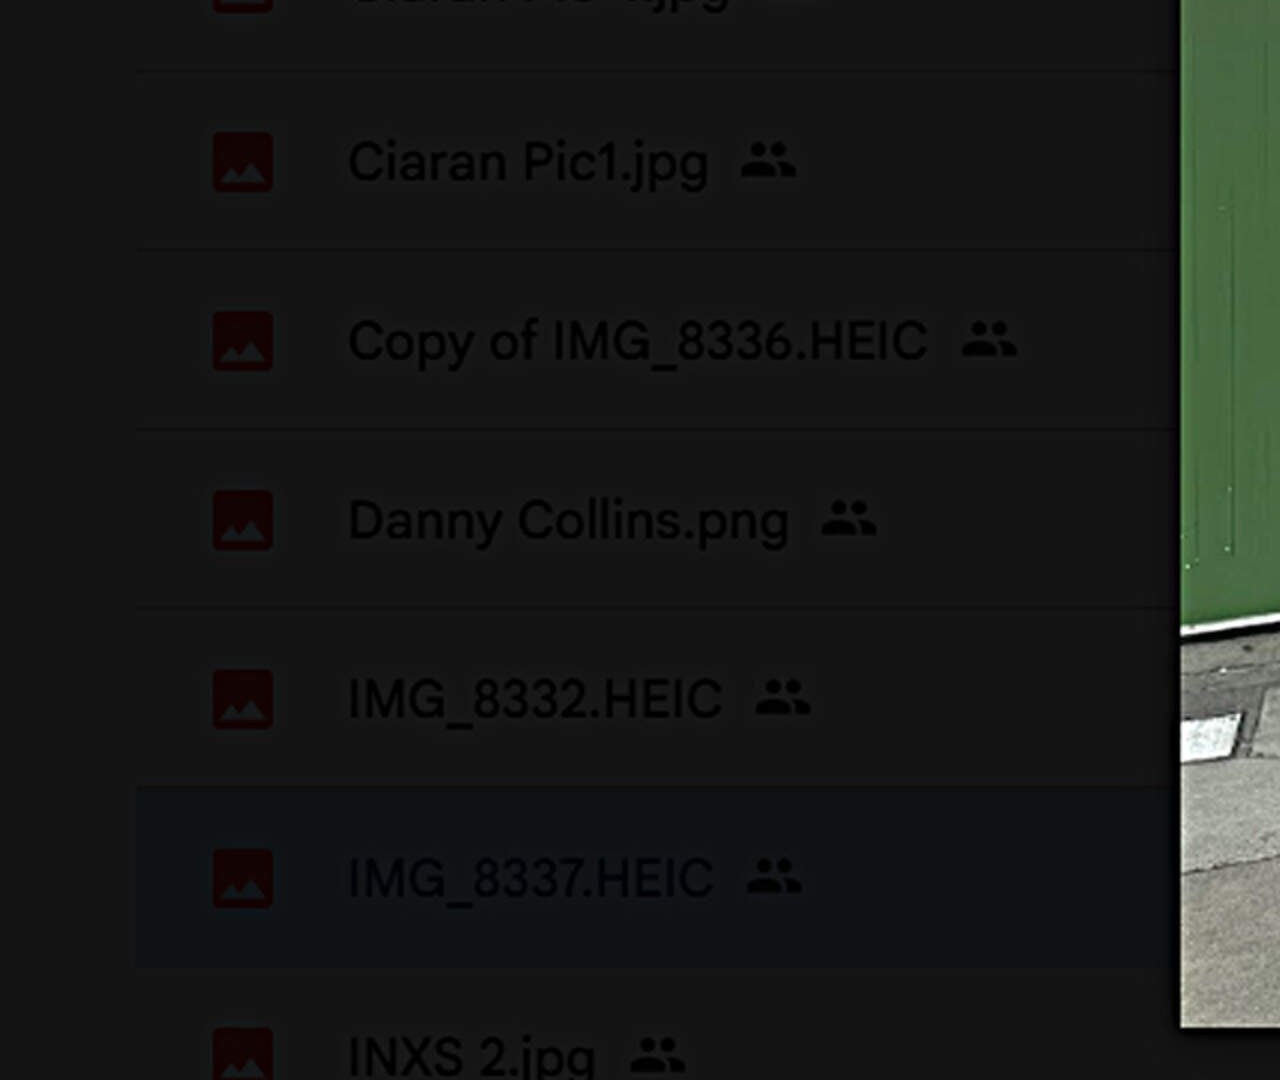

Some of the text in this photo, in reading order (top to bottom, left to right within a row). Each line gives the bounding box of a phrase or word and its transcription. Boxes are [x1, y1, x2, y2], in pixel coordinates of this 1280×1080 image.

[350, 139, 707, 192] Ciaran Pic1.jpg
[350, 317, 926, 371] Copy of IMG_8336.HEIC
[351, 496, 787, 551] Danny Collins.png
[351, 678, 722, 730] IMG_8332.HEIC
[351, 857, 713, 909] IMG_8337.HEIC
[351, 1034, 594, 1080] INXS 2.jpg
